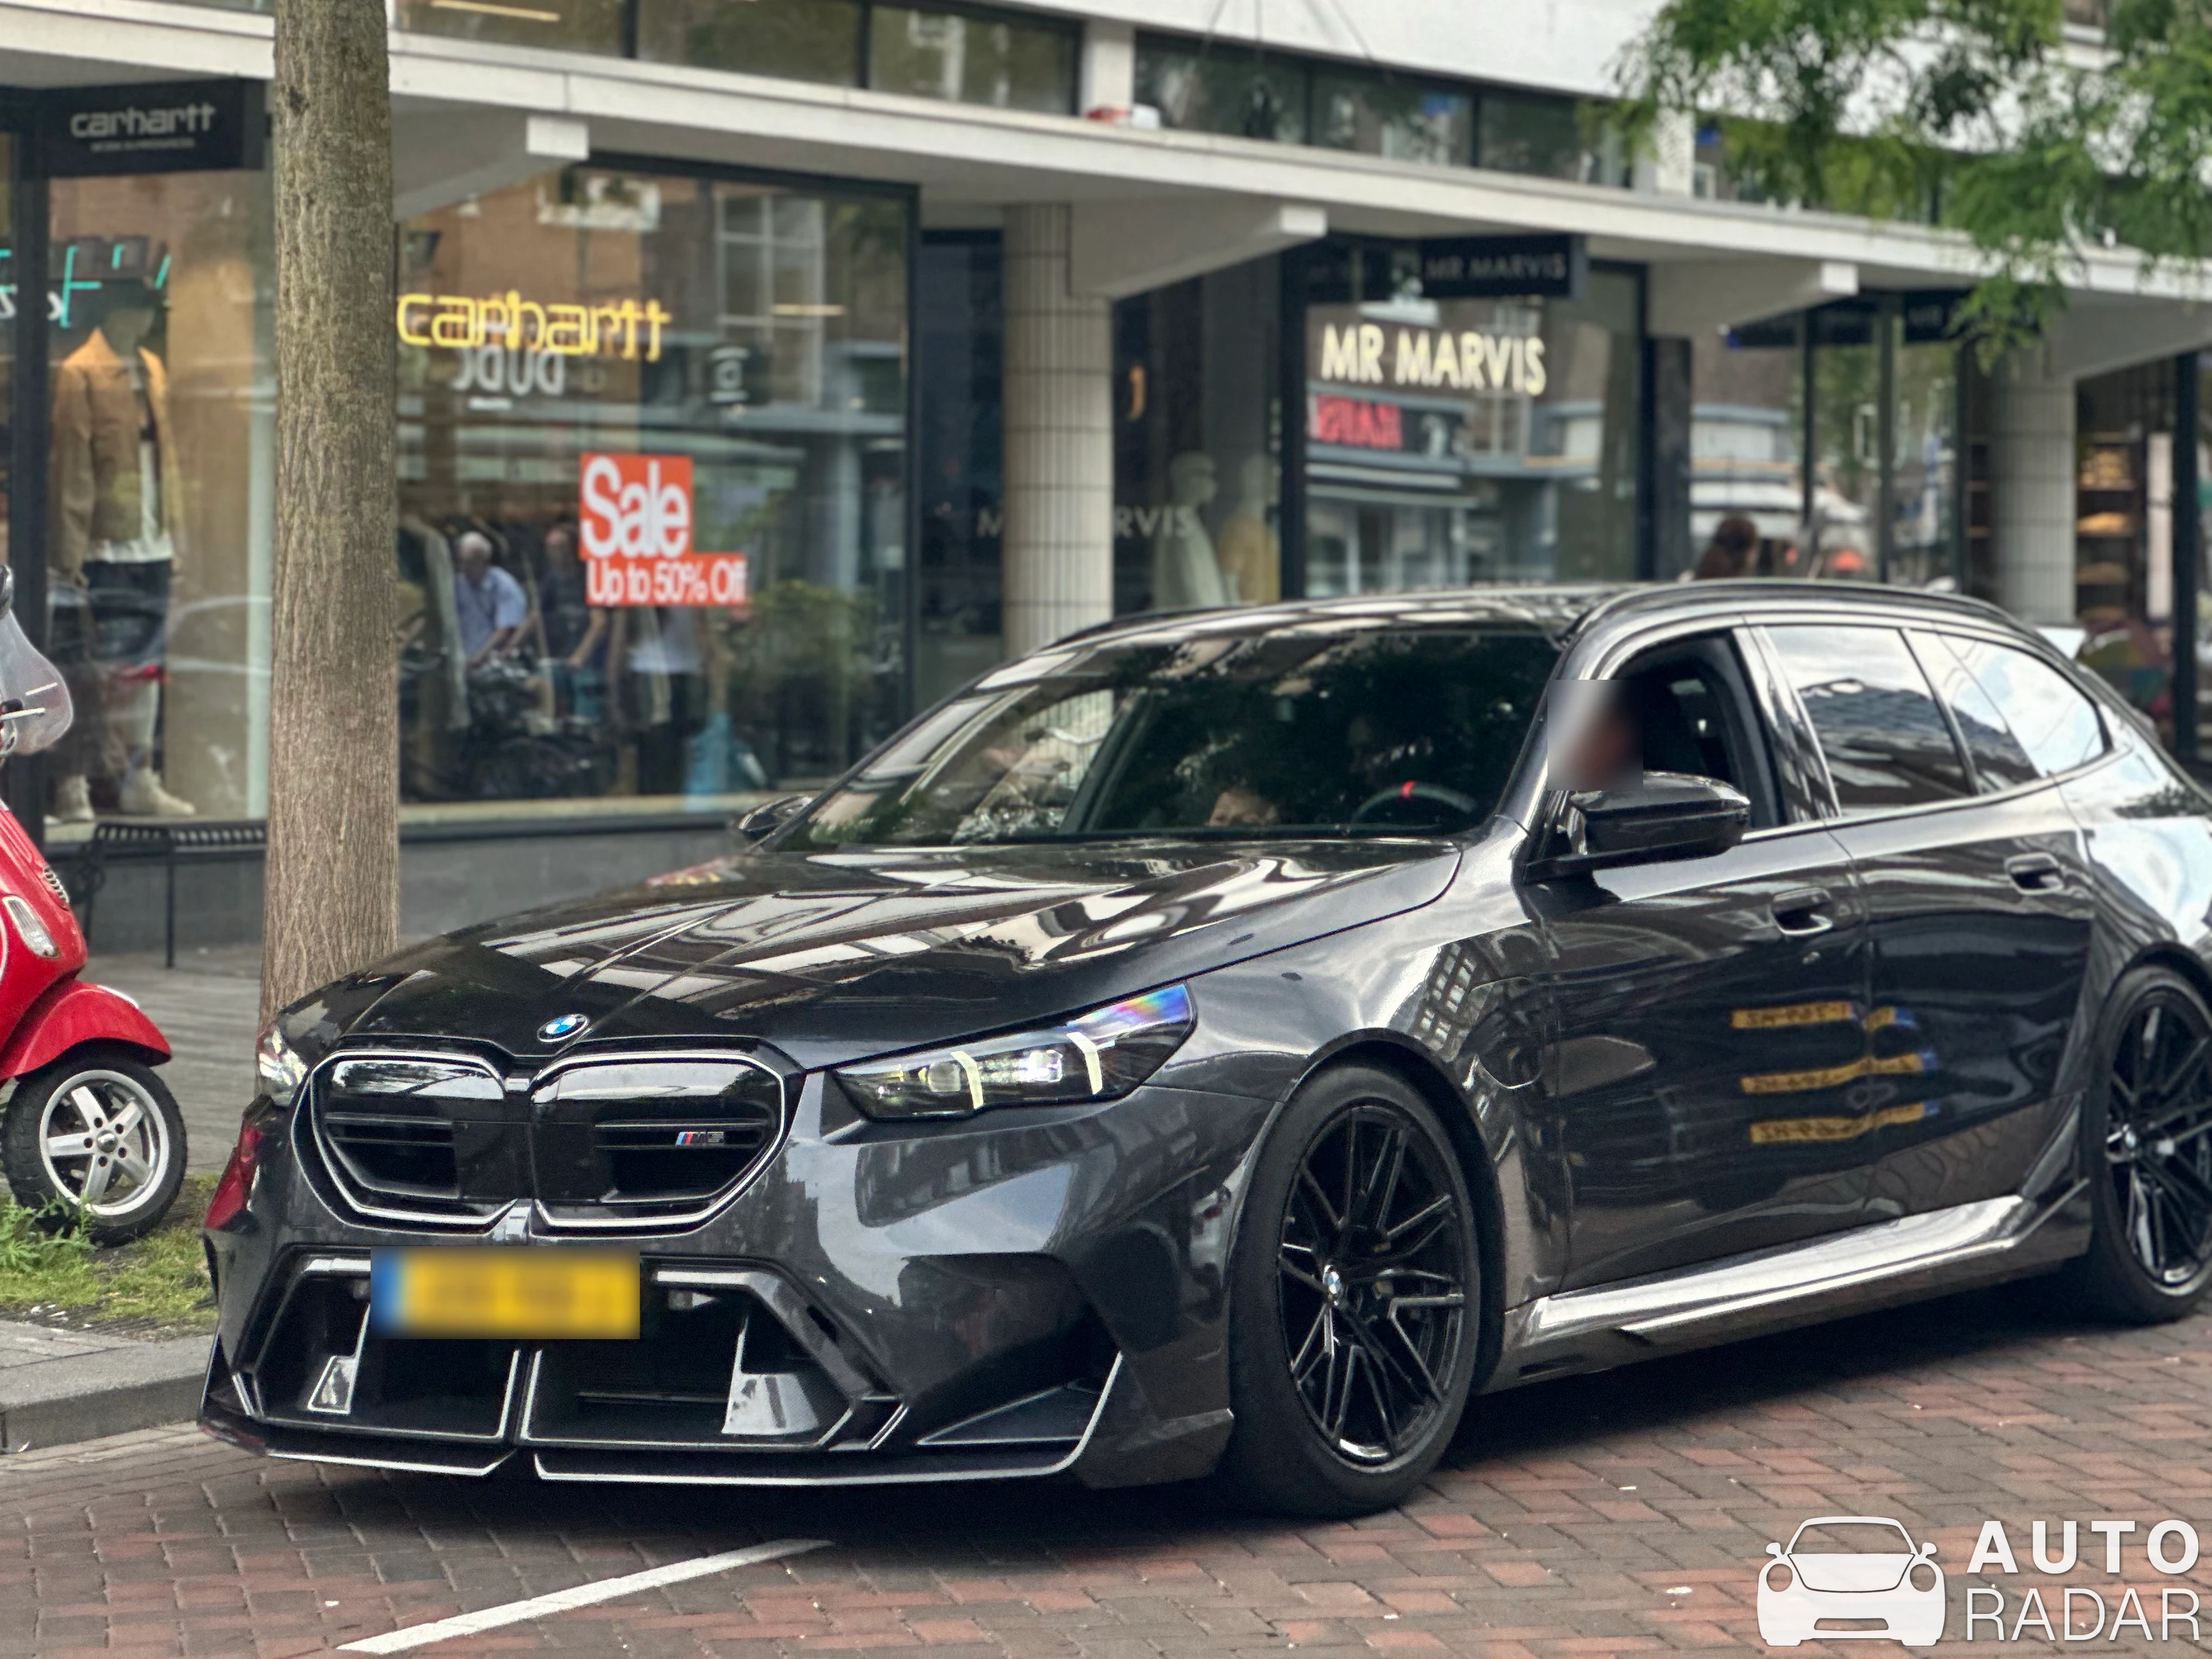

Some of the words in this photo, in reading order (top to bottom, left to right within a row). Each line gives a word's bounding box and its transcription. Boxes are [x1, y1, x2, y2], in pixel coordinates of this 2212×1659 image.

[70, 102, 216, 138] carhartt
[1425, 255, 1464, 281] MR
[1468, 252, 1567, 281] MARVIS
[396, 289, 671, 362] carhartt
[1320, 322, 1385, 383] MR
[1394, 328, 1547, 396] MARVIS
[581, 455, 690, 559] Sale
[587, 559, 625, 607] Up
[626, 562, 651, 602] to
[653, 561, 708, 603] 50%
[709, 559, 747, 603] Off
